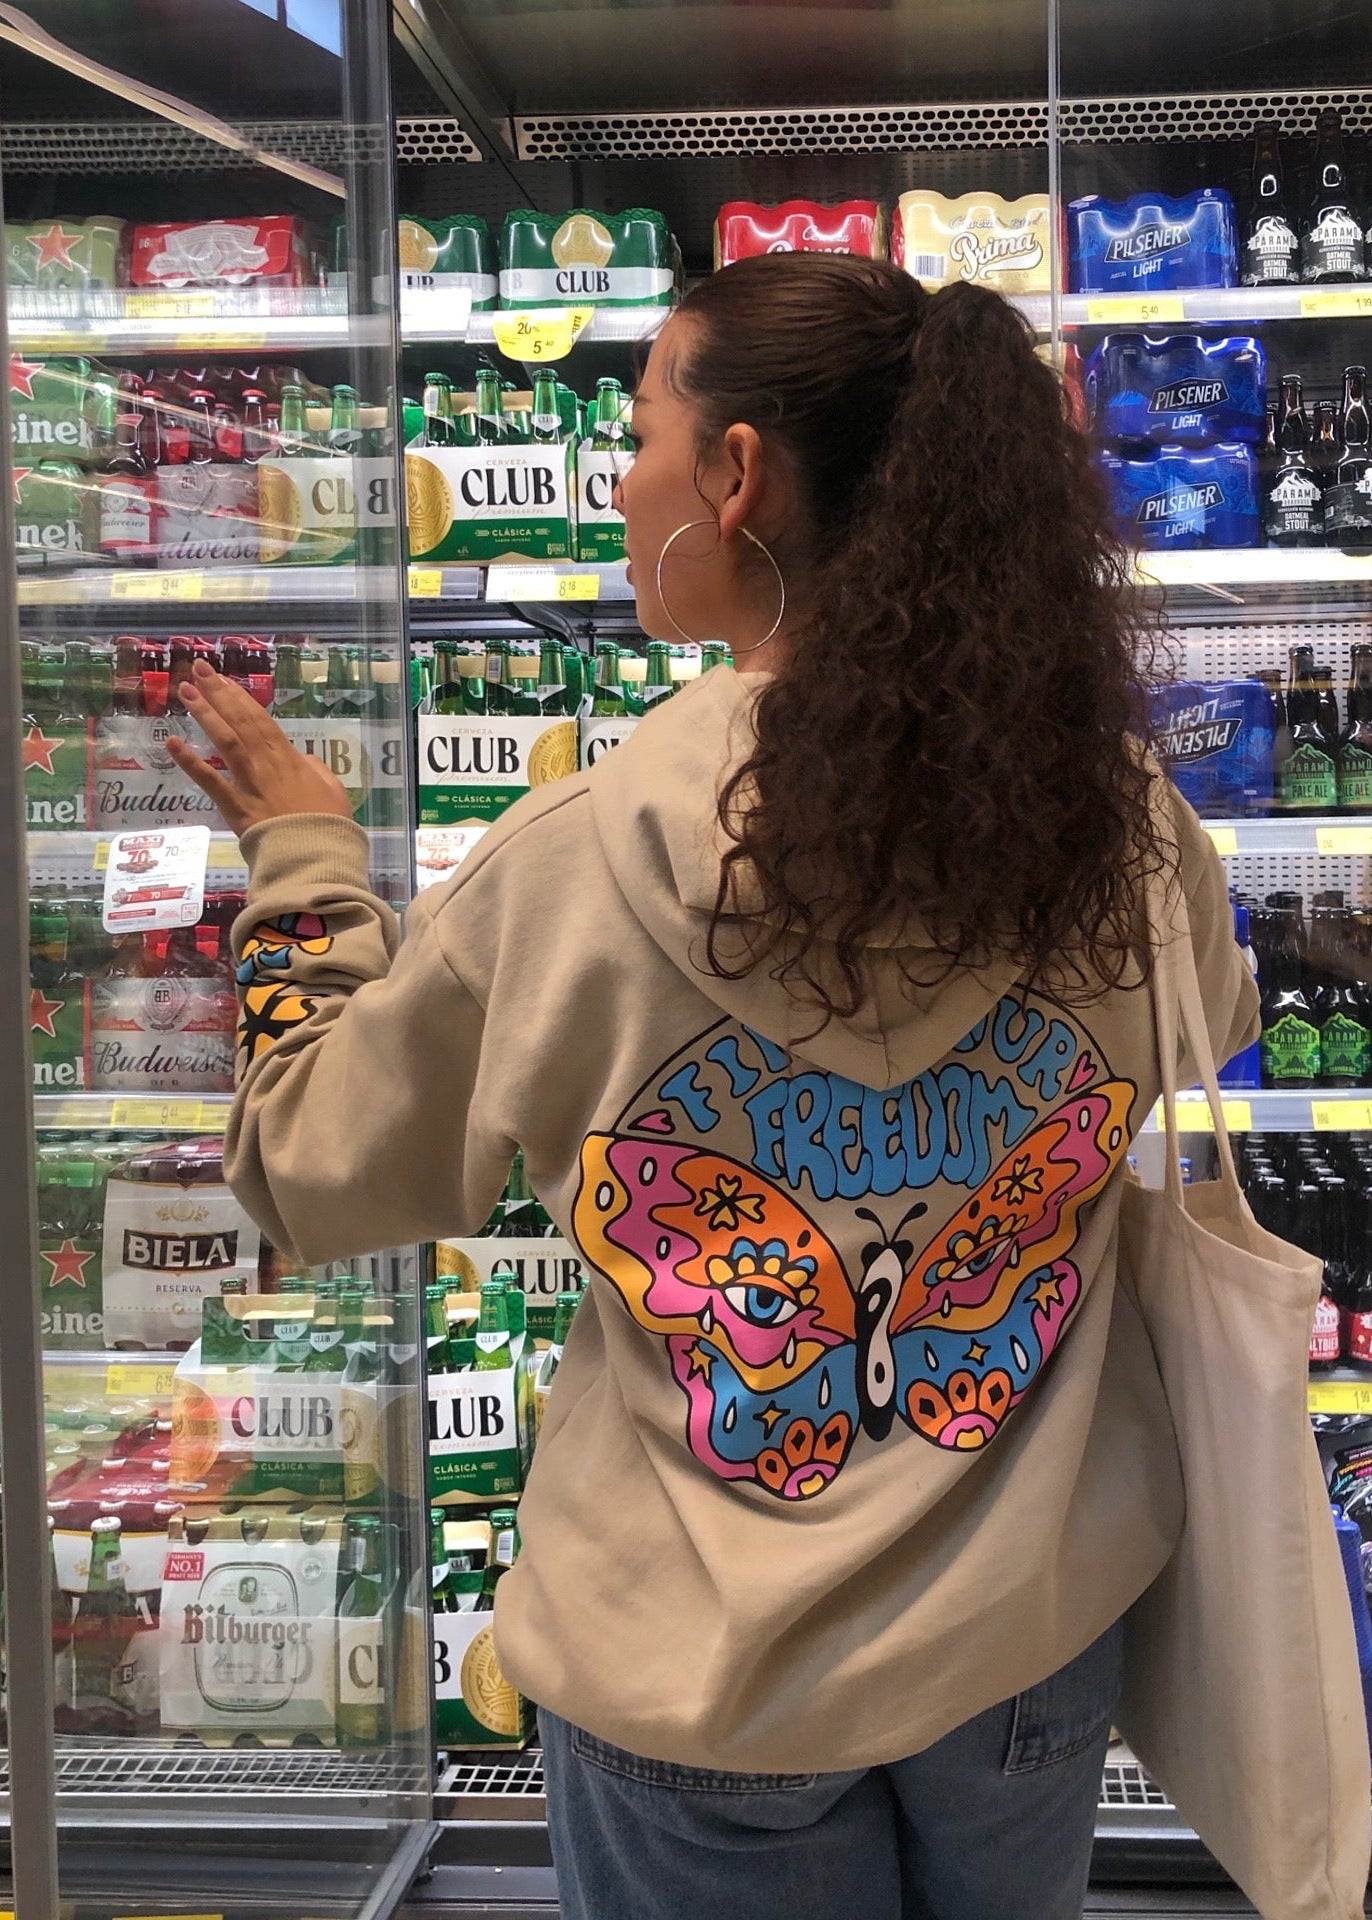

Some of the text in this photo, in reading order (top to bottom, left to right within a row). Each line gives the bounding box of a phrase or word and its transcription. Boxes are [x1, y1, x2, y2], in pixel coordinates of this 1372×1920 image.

[1112, 224, 1183, 260] PILSENER
[950, 231, 1037, 280] Prima
[1326, 259, 1352, 271] STOUT
[1132, 258, 1164, 280] LIGHT
[1263, 267, 1288, 278] STOUT
[556, 271, 610, 294] CLUB
[1154, 381, 1223, 411] PILSENER
[1171, 413, 1203, 429] LIGHT
[460, 466, 557, 507] CLUB
[1145, 485, 1217, 520] PILSENER
[491, 527, 532, 538] CLÁSICA
[1164, 519, 1197, 539] LIGHT
[1284, 519, 1309, 531] STOUT
[427, 735, 520, 774] CLUB
[452, 794, 492, 804] CLÁSICA
[1314, 782, 1328, 797] ALE
[743, 1062, 1038, 1201] FREEDOM
[128, 1234, 230, 1269] BIELA
[155, 1284, 202, 1294] RESERVA
[231, 1396, 334, 1438] CLUB
[433, 1462, 478, 1474] CLÁSICA
[170, 1560, 202, 1574] NO.1
[180, 1602, 313, 1650] Bitburger
